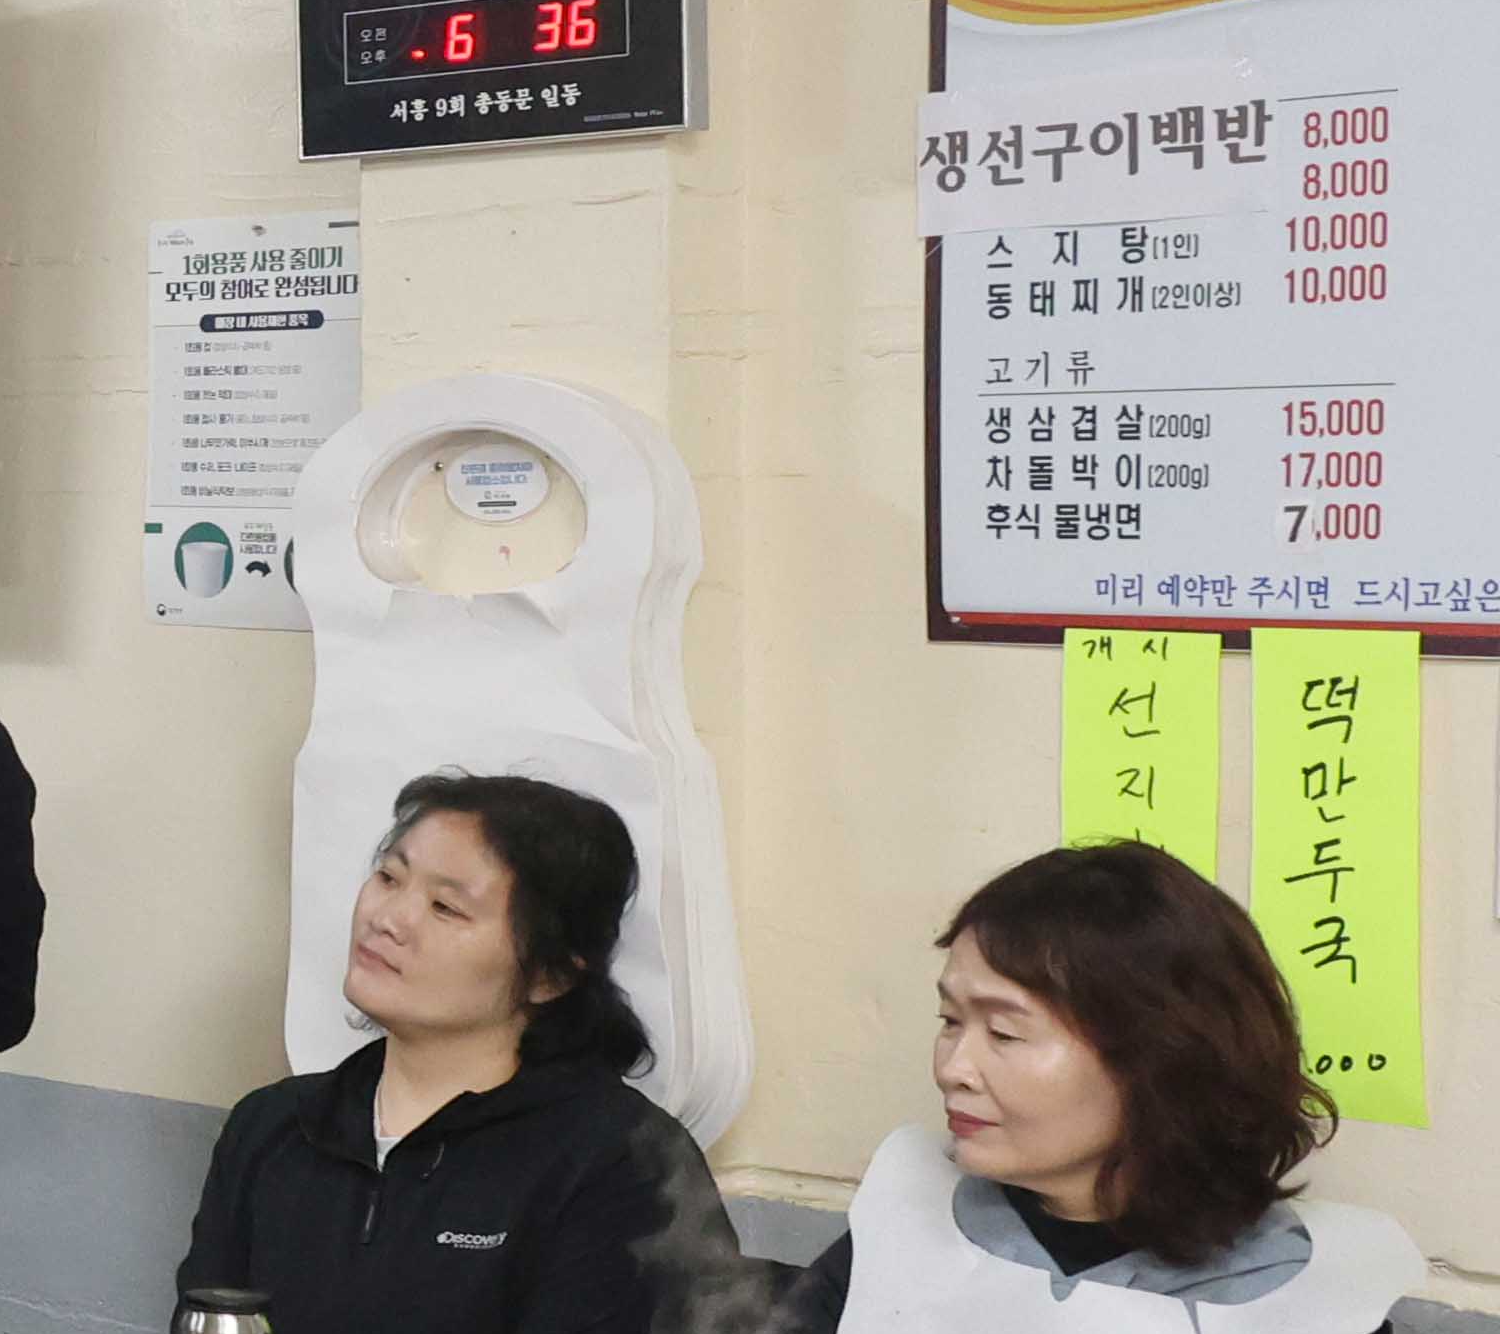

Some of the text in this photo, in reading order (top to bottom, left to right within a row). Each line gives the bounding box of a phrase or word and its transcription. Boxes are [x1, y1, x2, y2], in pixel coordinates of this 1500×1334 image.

[444, 13, 476, 62] 6
[389, 82, 582, 123] 서흥 9회 총동문 일동
[920, 98, 1390, 194] 생선구이백반 8,000
[1302, 158, 1390, 201] 8,000
[1284, 211, 1389, 254] 10,000
[250, 249, 285, 272] 사용
[289, 246, 343, 271] 줄이기
[165, 273, 359, 303] 모두의 참여로 완성됩니다
[1283, 264, 1388, 305] 10,000
[1281, 399, 1385, 438] 15,000
[1280, 451, 1383, 489] 17,000
[985, 502, 1382, 544] 후식 물냉면 7,000
[1095, 574, 1144, 608] 미리
[1156, 574, 1237, 608] 예약만
[1246, 575, 1331, 610] 주시면
